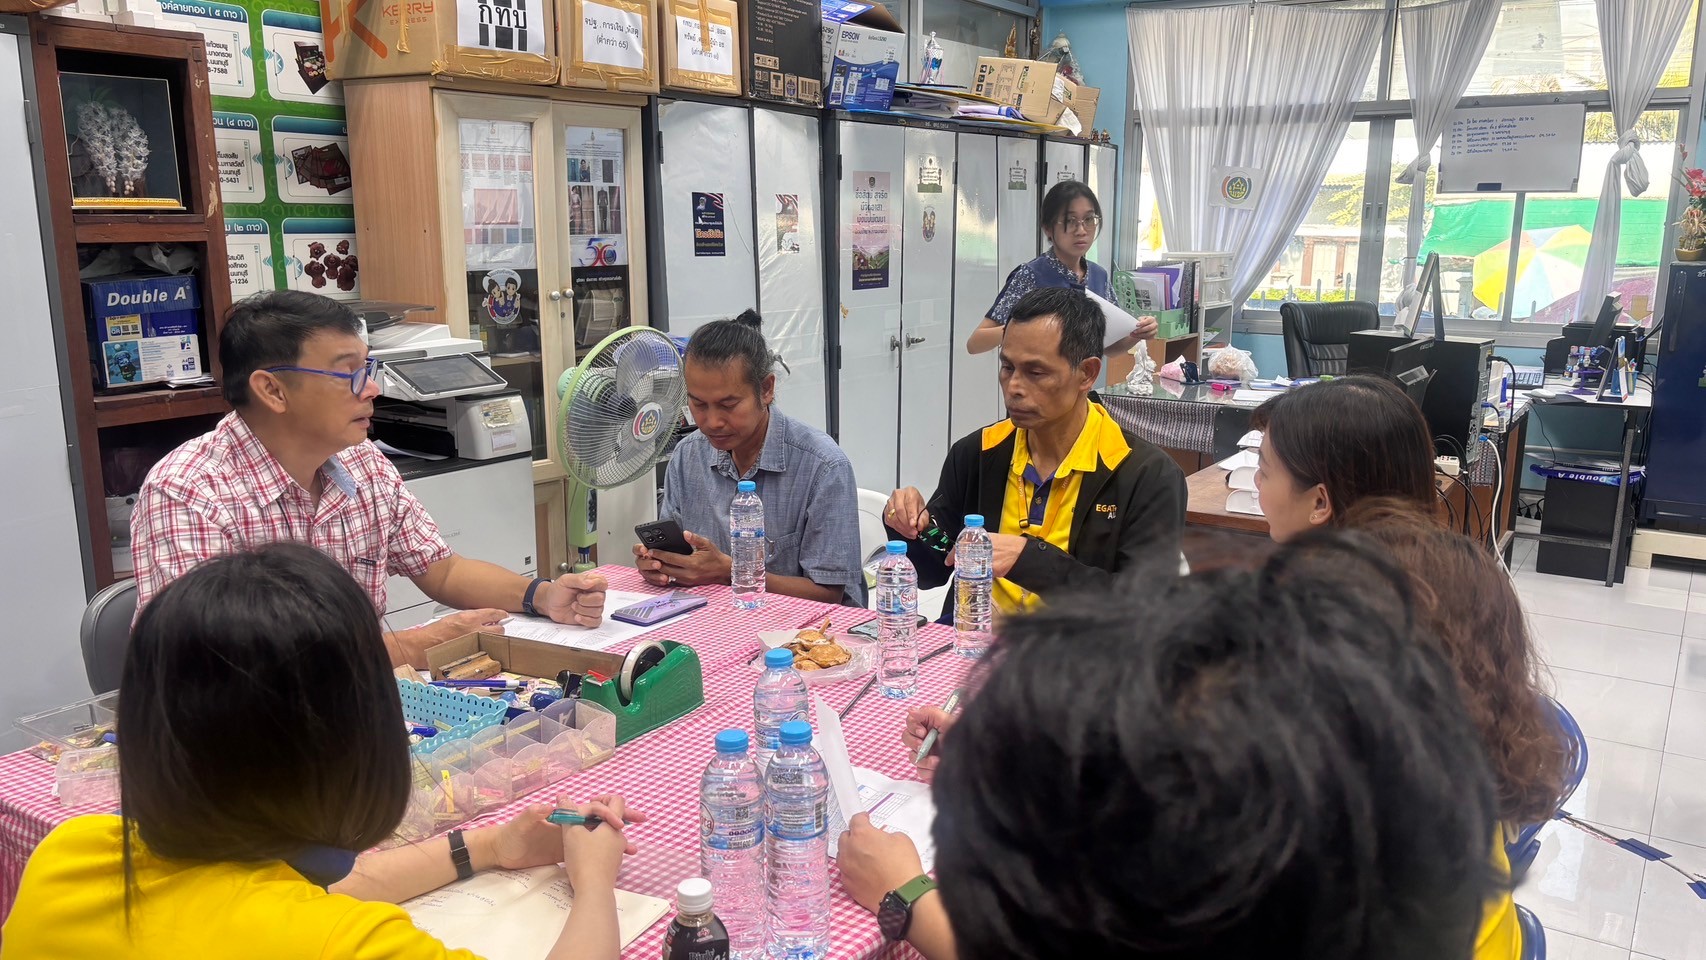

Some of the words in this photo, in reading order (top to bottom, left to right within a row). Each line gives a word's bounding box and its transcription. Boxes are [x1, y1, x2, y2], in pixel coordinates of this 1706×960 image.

[477, 4, 527, 30] กทบ
[841, 31, 860, 41] EPSON
[107, 289, 169, 307] Double
[173, 286, 187, 301] A
[1569, 473, 1608, 483] Double
